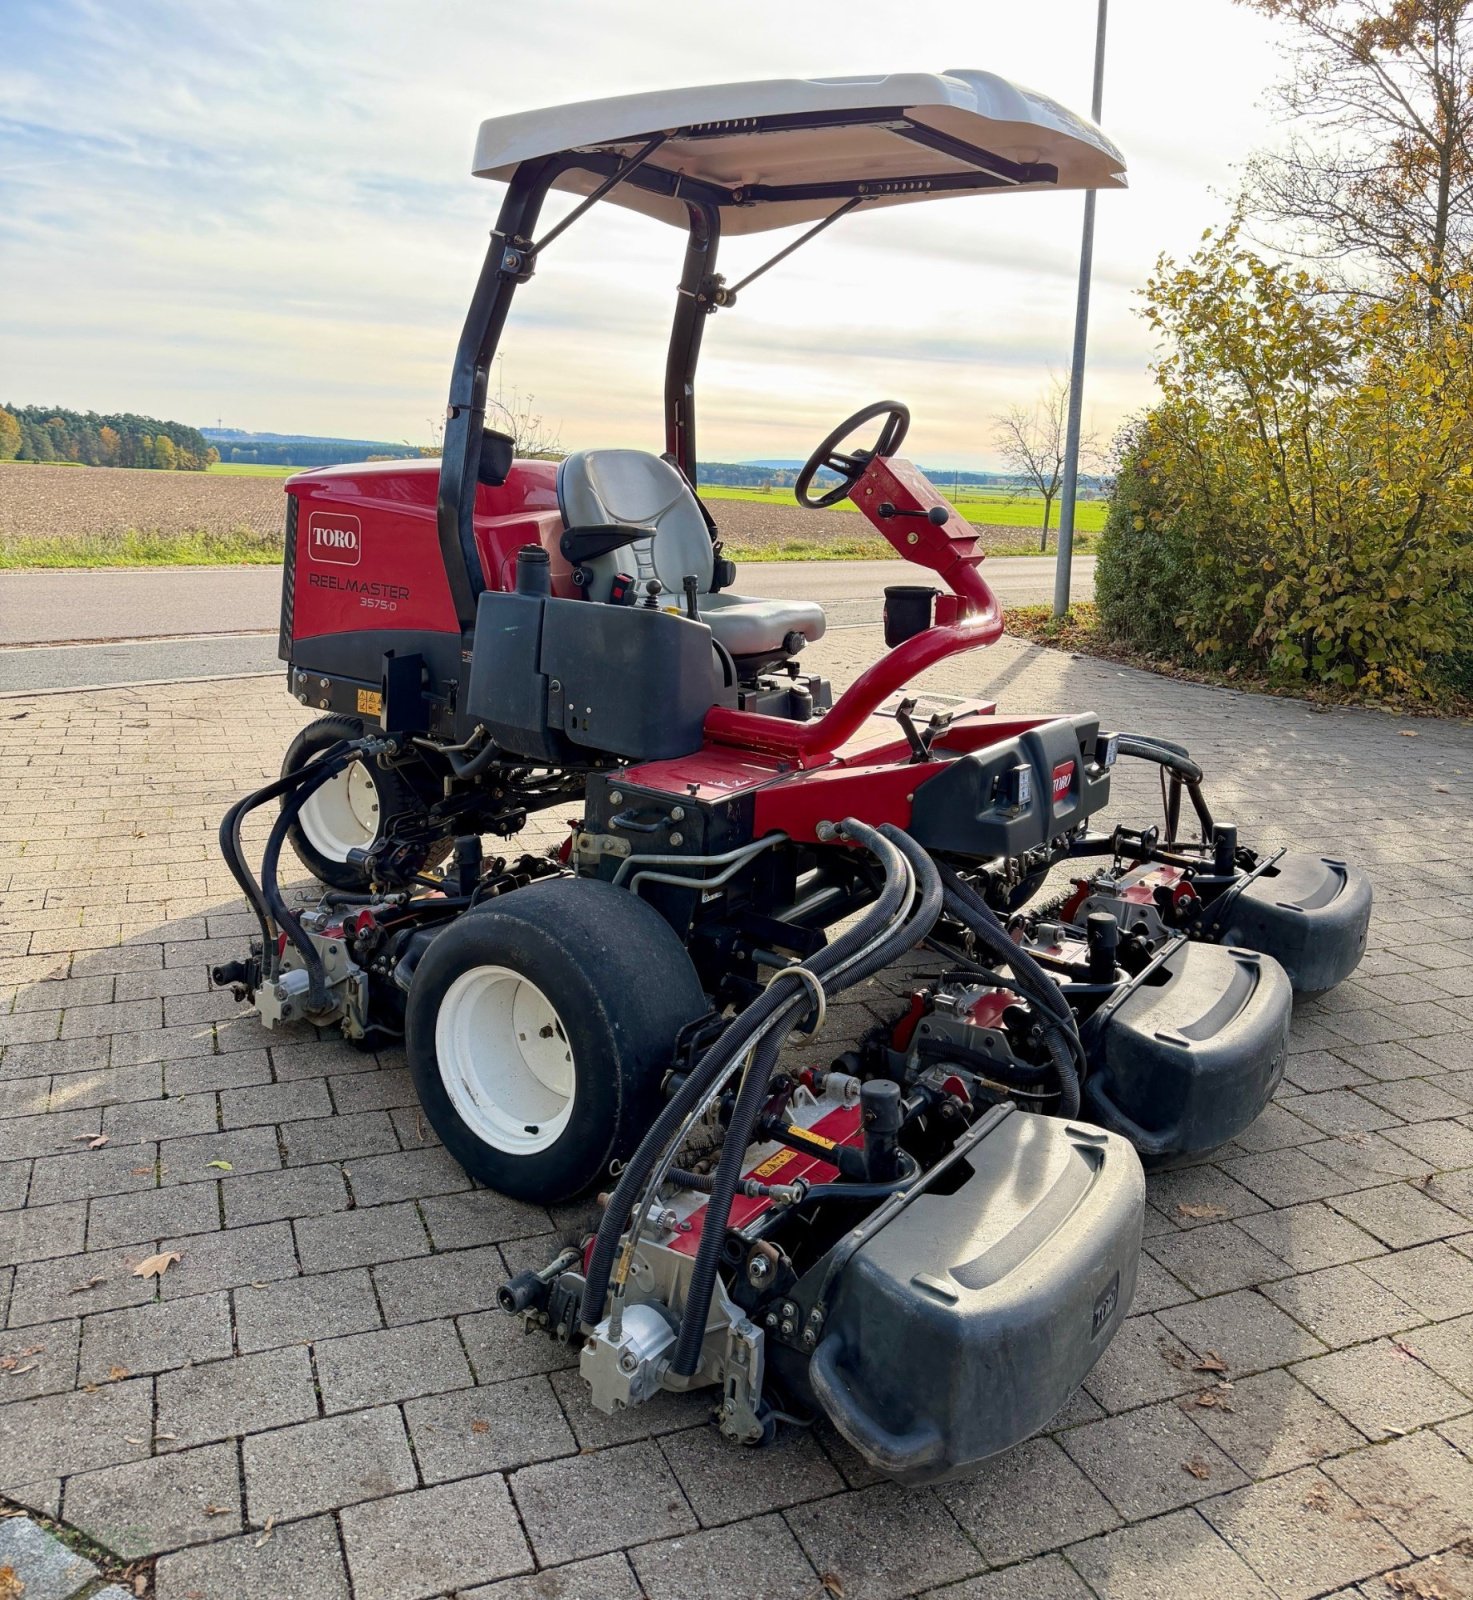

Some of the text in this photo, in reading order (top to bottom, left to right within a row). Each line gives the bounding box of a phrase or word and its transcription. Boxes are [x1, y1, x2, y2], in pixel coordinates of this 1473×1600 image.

[313, 527, 357, 549] TORO
[309, 573, 410, 600] REELMASTER
[1053, 773, 1071, 793] TORO
